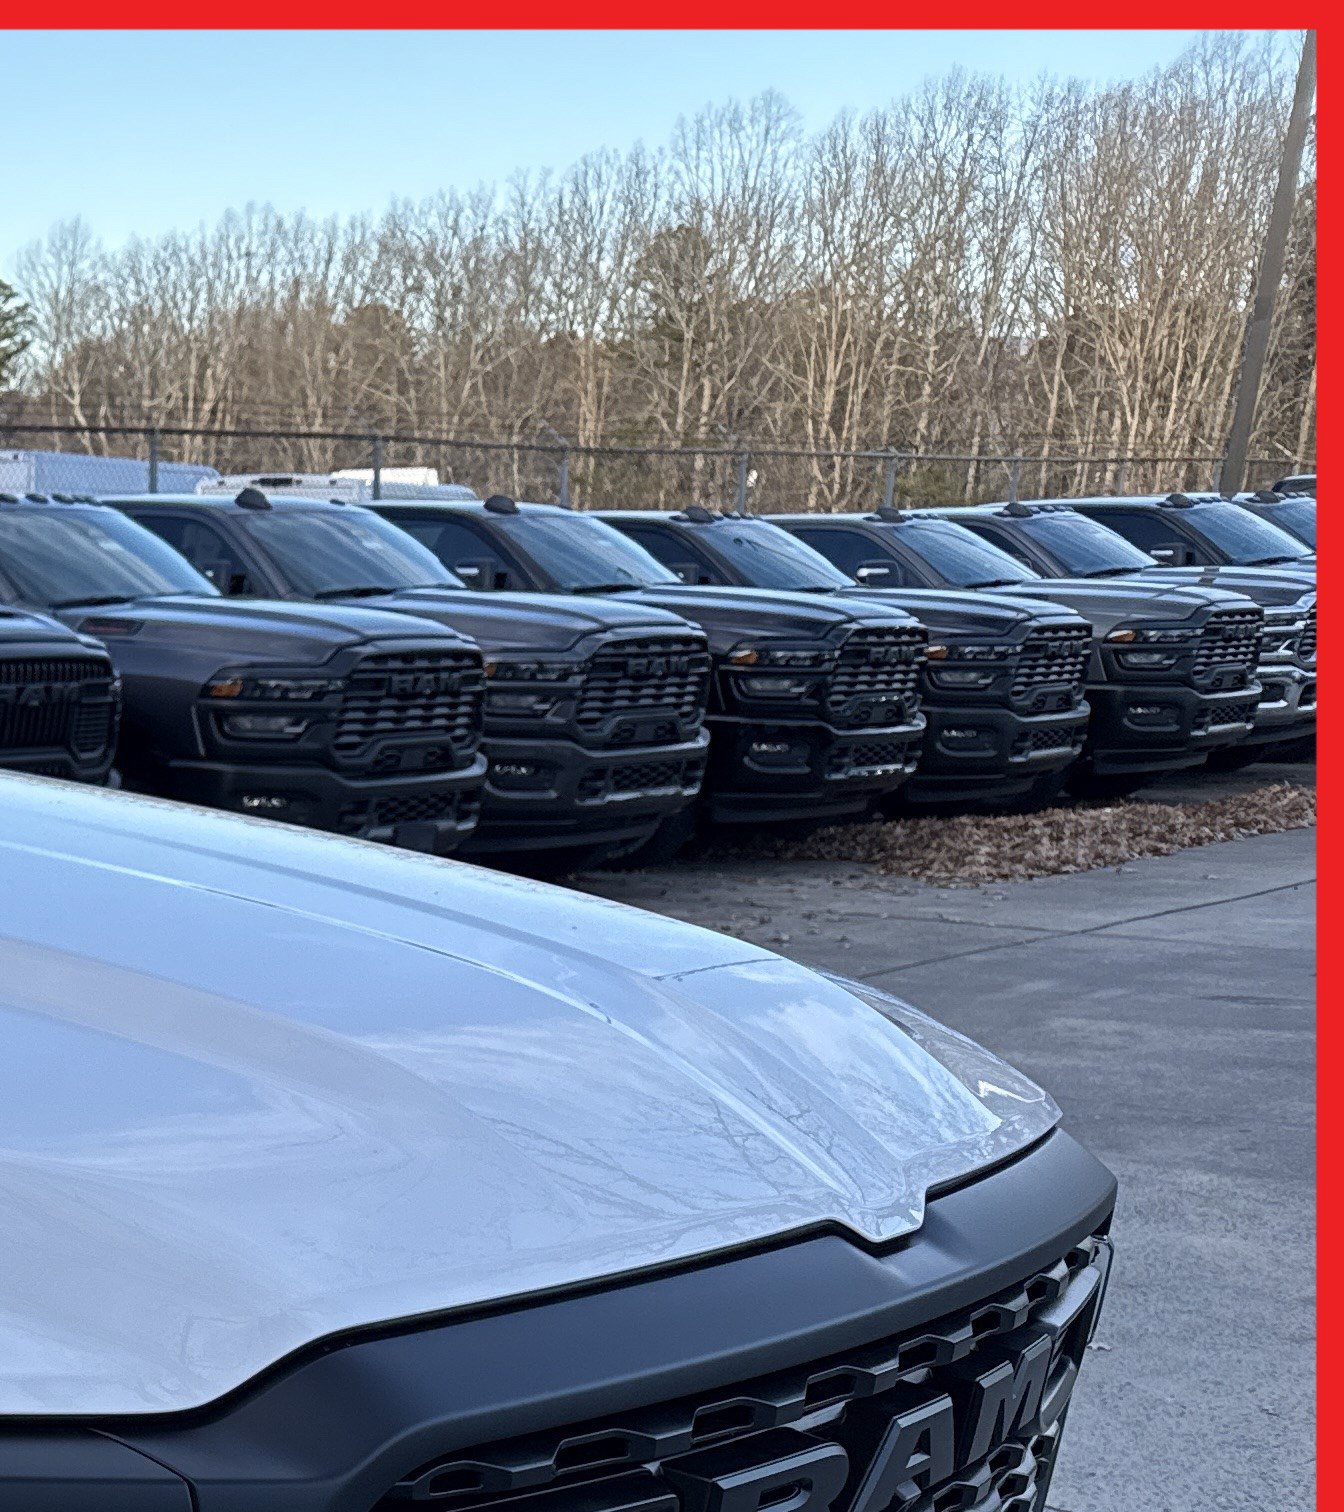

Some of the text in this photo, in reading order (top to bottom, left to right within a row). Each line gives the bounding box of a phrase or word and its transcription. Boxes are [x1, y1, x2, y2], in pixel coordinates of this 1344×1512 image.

[868, 645, 915, 662] RAM
[627, 656, 689, 676] RAM
[389, 672, 462, 693] RAM
